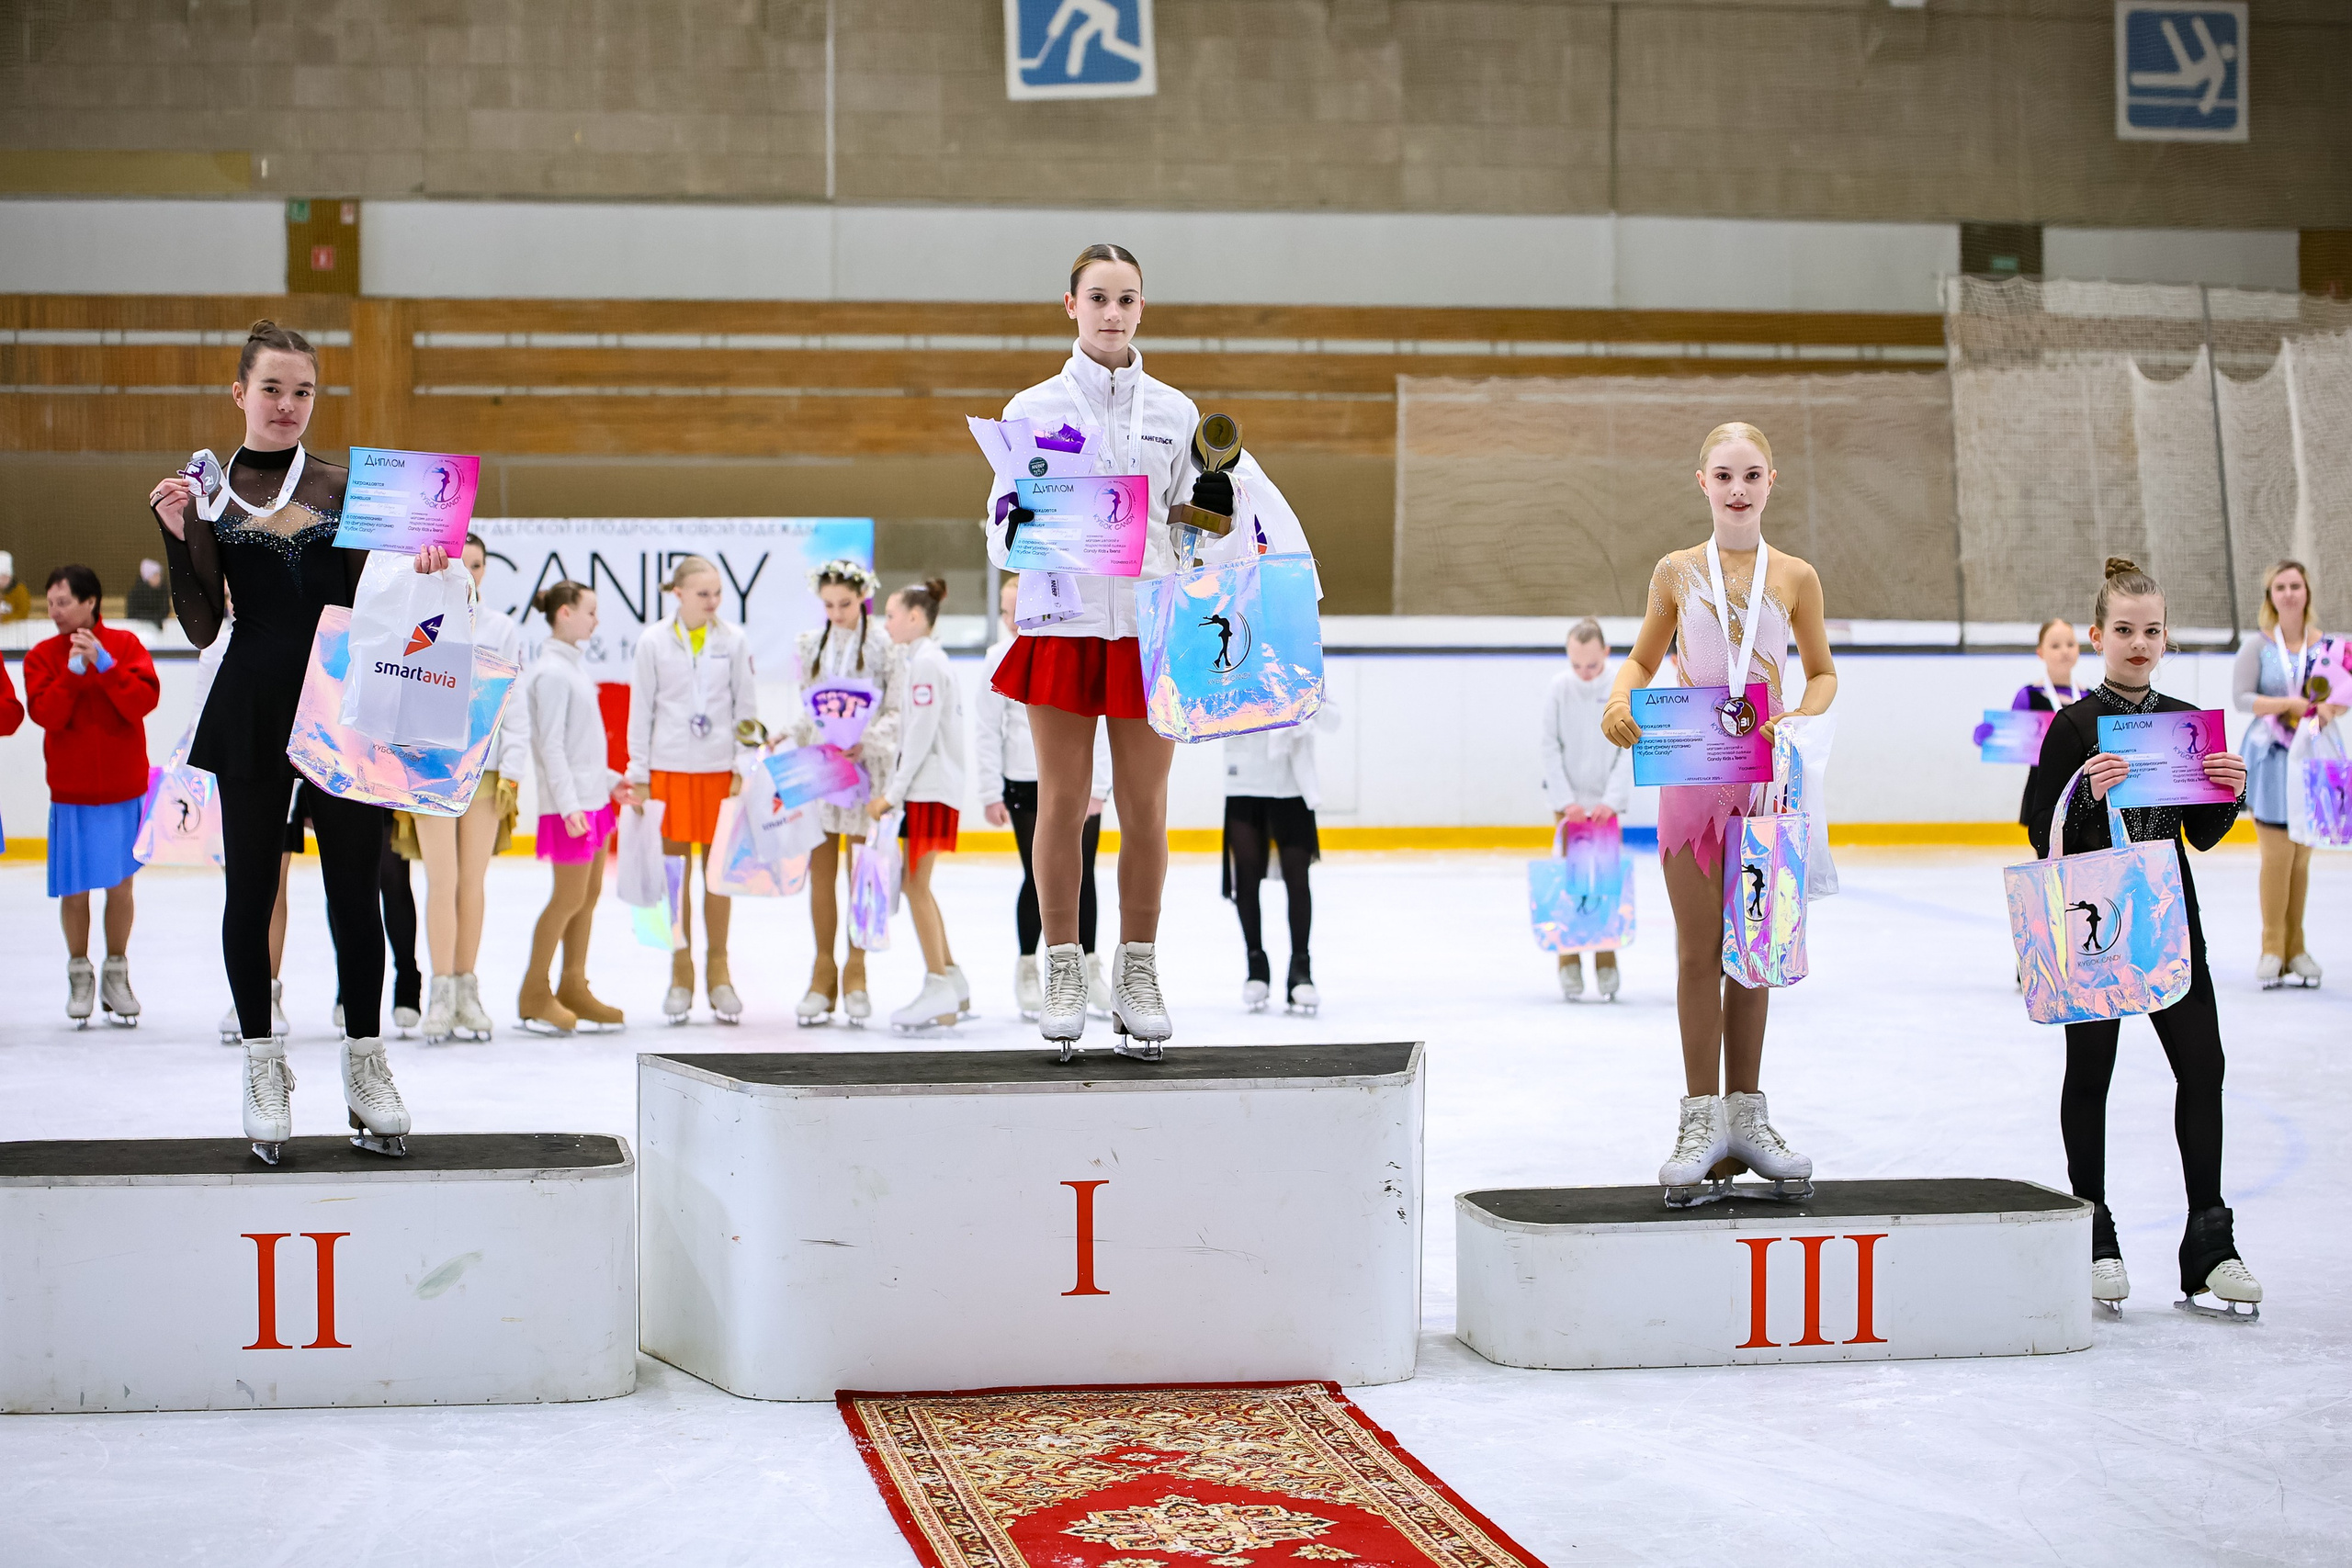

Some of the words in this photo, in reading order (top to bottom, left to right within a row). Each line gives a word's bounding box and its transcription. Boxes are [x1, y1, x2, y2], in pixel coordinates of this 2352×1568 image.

[1141, 434, 1173, 445] ХАНГЕЛЬСК
[374, 661, 457, 688] smartavia
[371, 743, 397, 756] КУБОК
[2077, 958, 2100, 968] КУБОК
[1059, 1179, 1111, 1296] I
[240, 1232, 352, 1350] II
[1735, 1233, 1889, 1349] III
